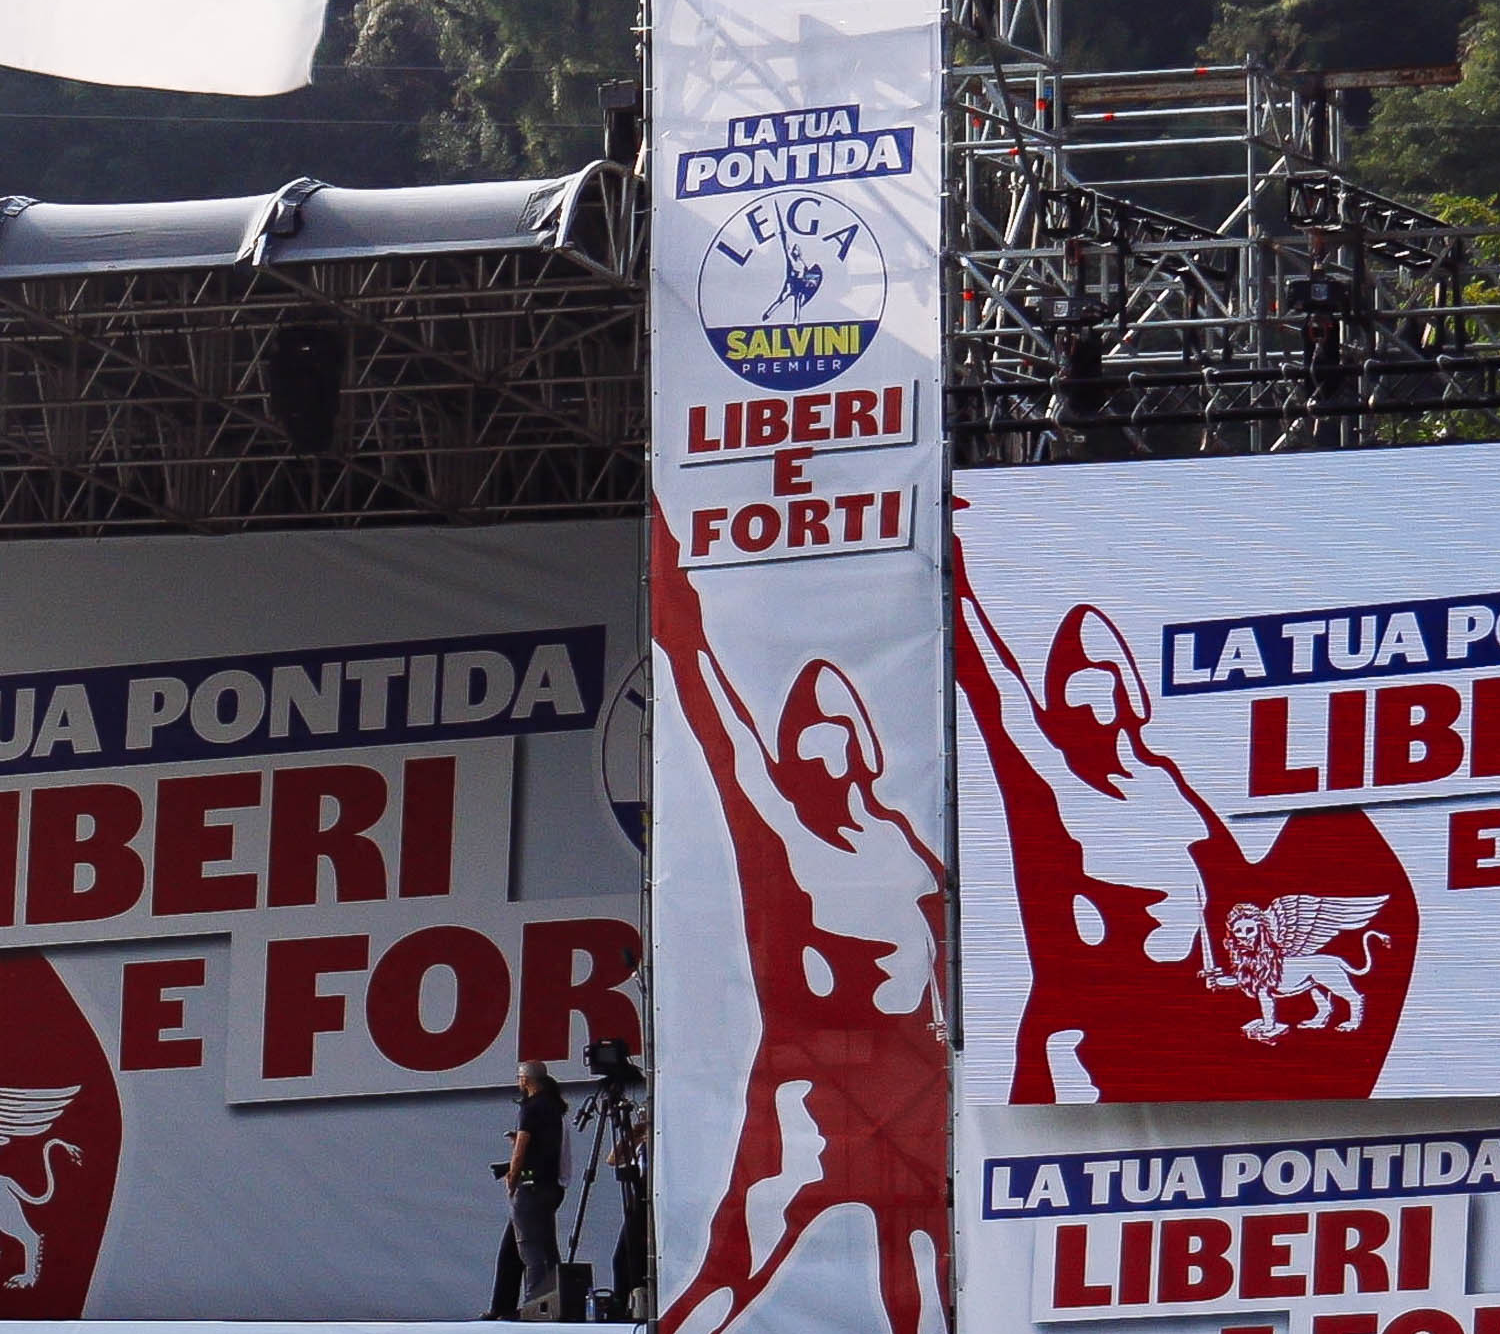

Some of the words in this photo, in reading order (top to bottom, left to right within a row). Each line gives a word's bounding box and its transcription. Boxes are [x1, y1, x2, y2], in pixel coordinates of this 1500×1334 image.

[735, 120, 776, 146] LA
[788, 110, 854, 138] TUA
[685, 136, 902, 191] PONTIDA
[716, 196, 861, 266] LEGA
[725, 324, 861, 360] SALVINI
[741, 359, 843, 373] PREMIER
[687, 386, 902, 454] LIBERI
[773, 447, 814, 497] E
[690, 491, 901, 557] FORTI
[1172, 622, 1267, 685] LA
[1282, 611, 1435, 675] TUA
[125, 643, 585, 751] PONTIDA
[119, 958, 205, 1071] E
[261, 918, 643, 1080] FOR
[991, 1161, 1066, 1211] LA
[1083, 1154, 1201, 1206] TUA
[1051, 1205, 1434, 1310] LIBERI
